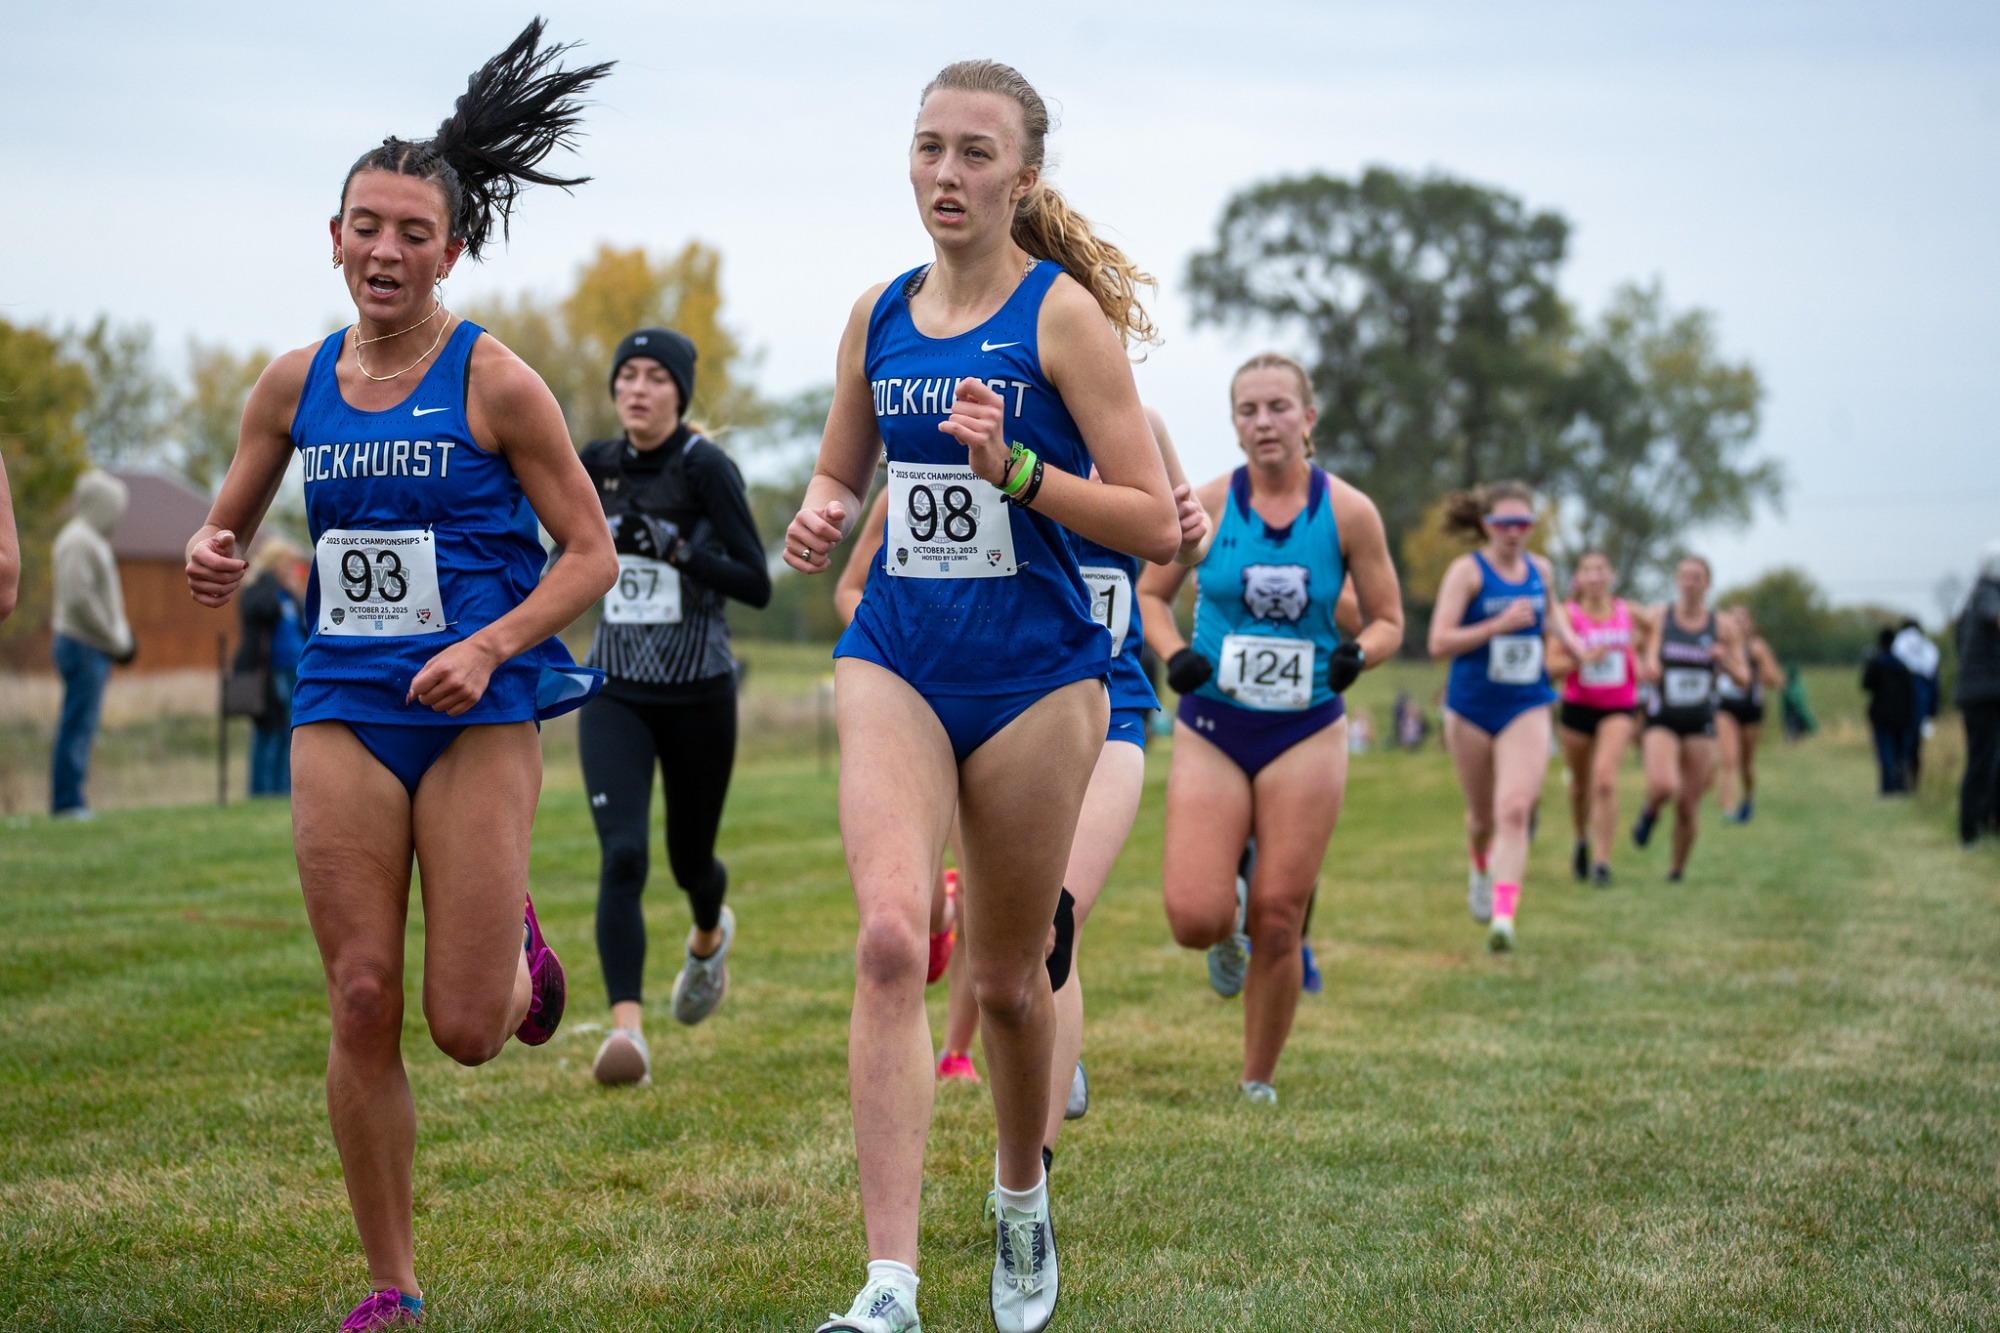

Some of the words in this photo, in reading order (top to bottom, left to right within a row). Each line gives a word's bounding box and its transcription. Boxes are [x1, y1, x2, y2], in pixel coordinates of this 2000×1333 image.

[871, 377, 1032, 418] OCKHUST
[301, 440, 456, 483] OCKHURST
[896, 470, 908, 478] 2025
[909, 471, 926, 480] GLVC
[927, 472, 984, 481] CHAMPIONSH
[908, 484, 977, 542] 98
[326, 537, 340, 545] 2025
[341, 537, 359, 546] GLVC
[360, 536, 420, 546] CHAMPIONSHIPS
[913, 546, 945, 554] OCTOBER
[946, 547, 958, 556] 25,
[342, 550, 407, 602] 93
[620, 568, 658, 600] 67
[349, 606, 379, 614] OCTOBER
[380, 606, 390, 615] 25,
[392, 606, 408, 614] 2025
[1099, 585, 1116, 629] 1
[1234, 649, 1303, 687] 124
